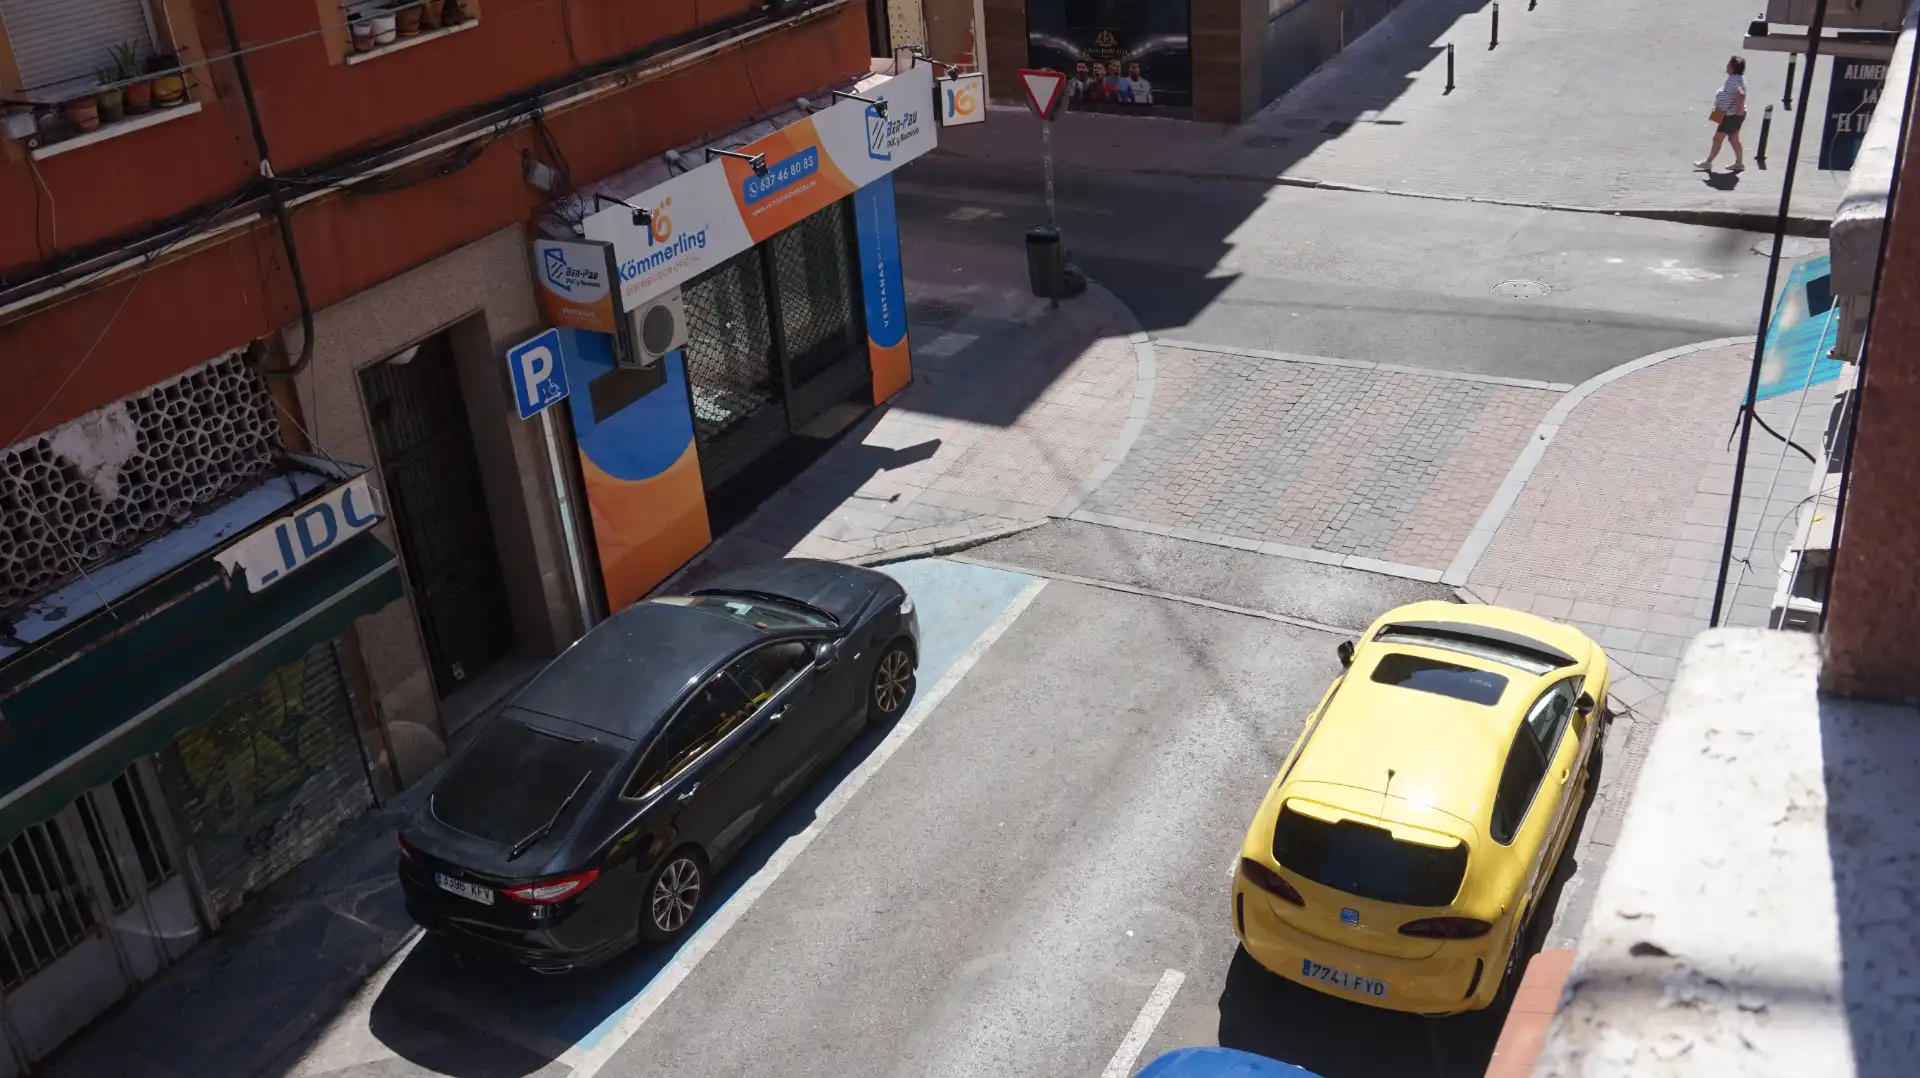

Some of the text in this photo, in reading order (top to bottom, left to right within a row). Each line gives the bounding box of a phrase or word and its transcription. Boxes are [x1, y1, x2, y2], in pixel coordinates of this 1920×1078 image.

[1856, 111, 1872, 133] TÍ
[760, 155, 814, 192] 637 46 80 83
[617, 229, 706, 283] Kömmerling
[625, 267, 673, 297] DISTRIBUIDOR
[877, 262, 890, 329] VENTANAS
[521, 345, 553, 406] P
[1312, 963, 1384, 996] 7741 FYD
